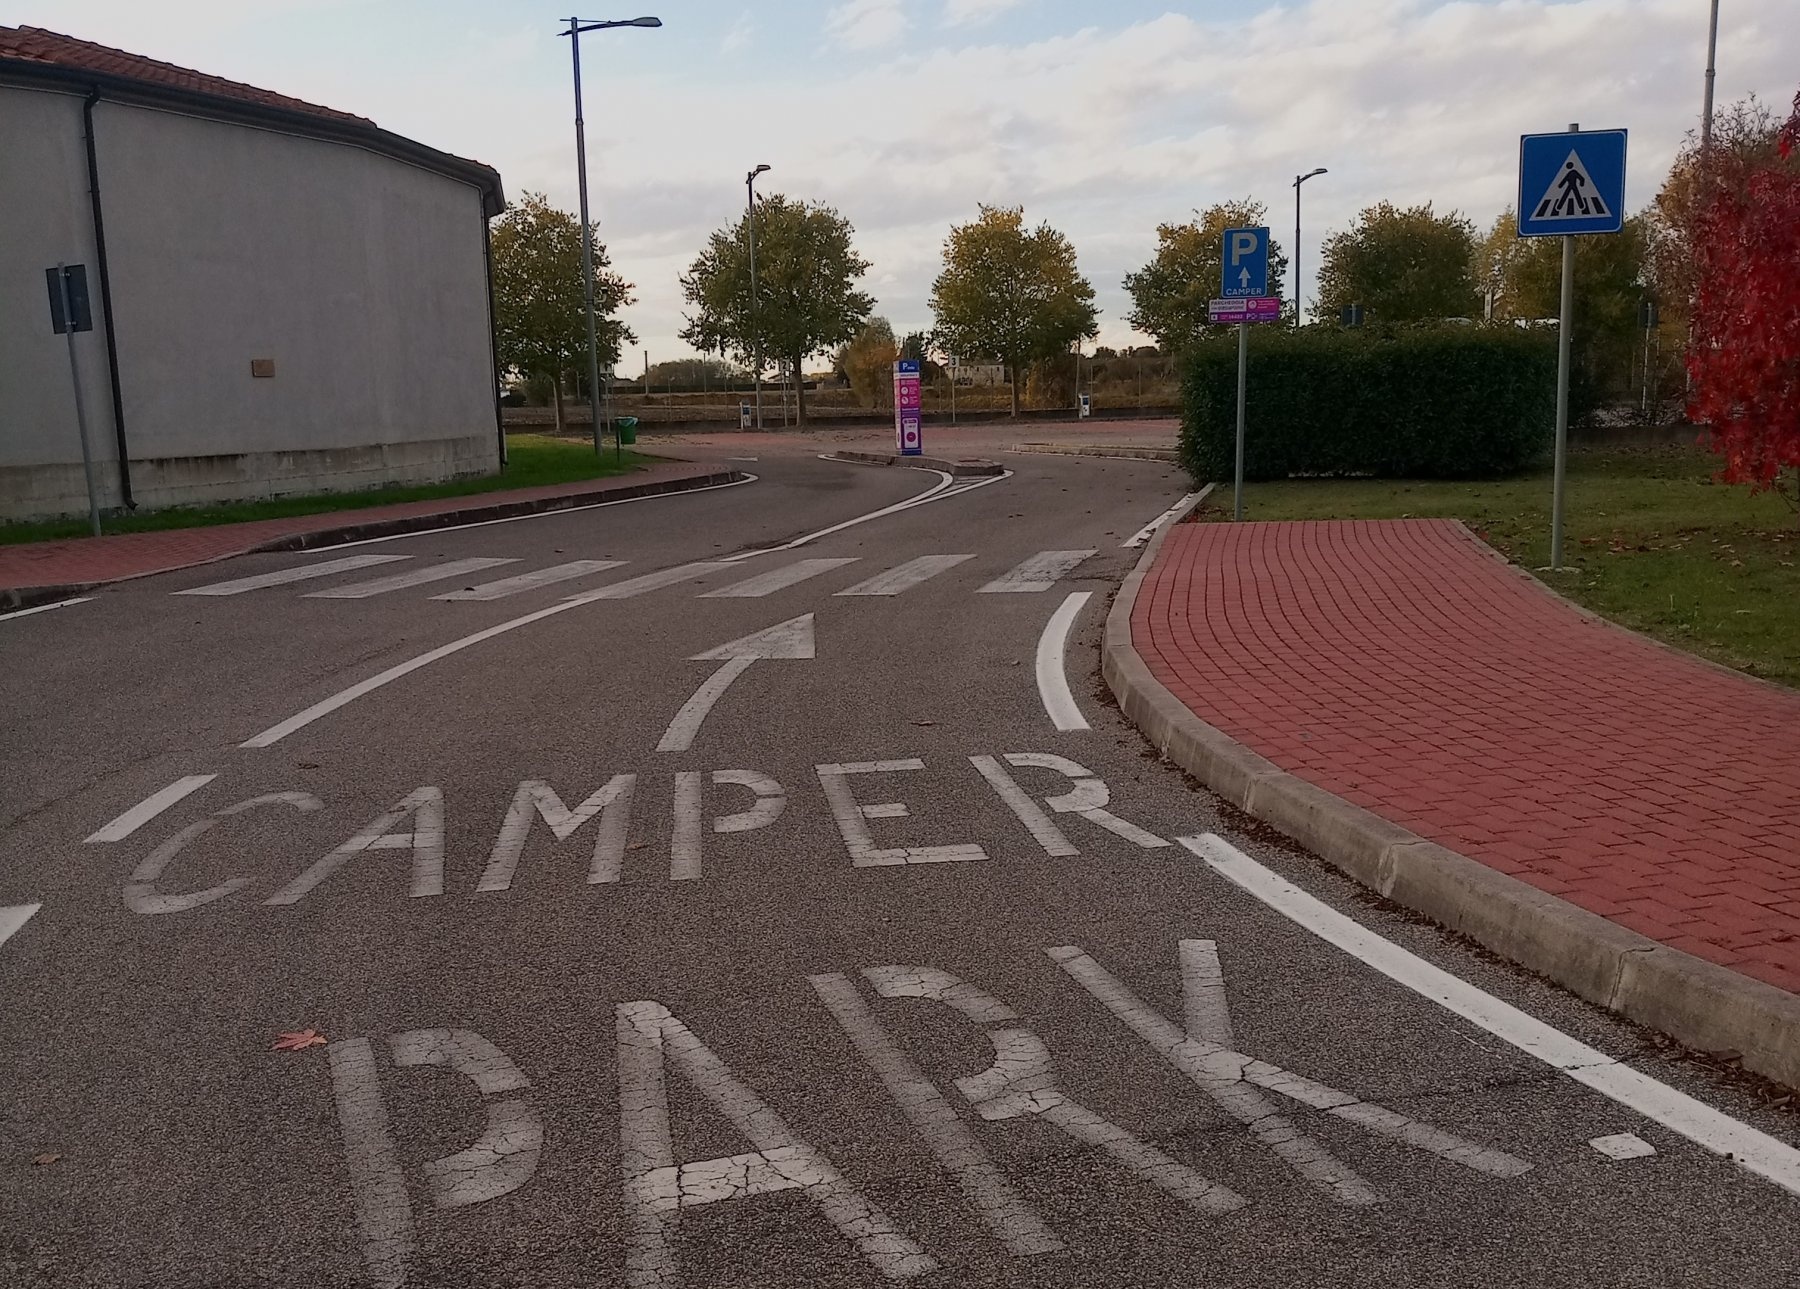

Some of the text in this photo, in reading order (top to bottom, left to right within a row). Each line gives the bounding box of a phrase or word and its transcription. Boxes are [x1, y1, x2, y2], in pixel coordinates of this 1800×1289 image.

[1231, 232, 1258, 266] P
[782, 360, 787, 369] 2
[951, 357, 956, 366] 3
[123, 752, 1172, 914] CAMPER
